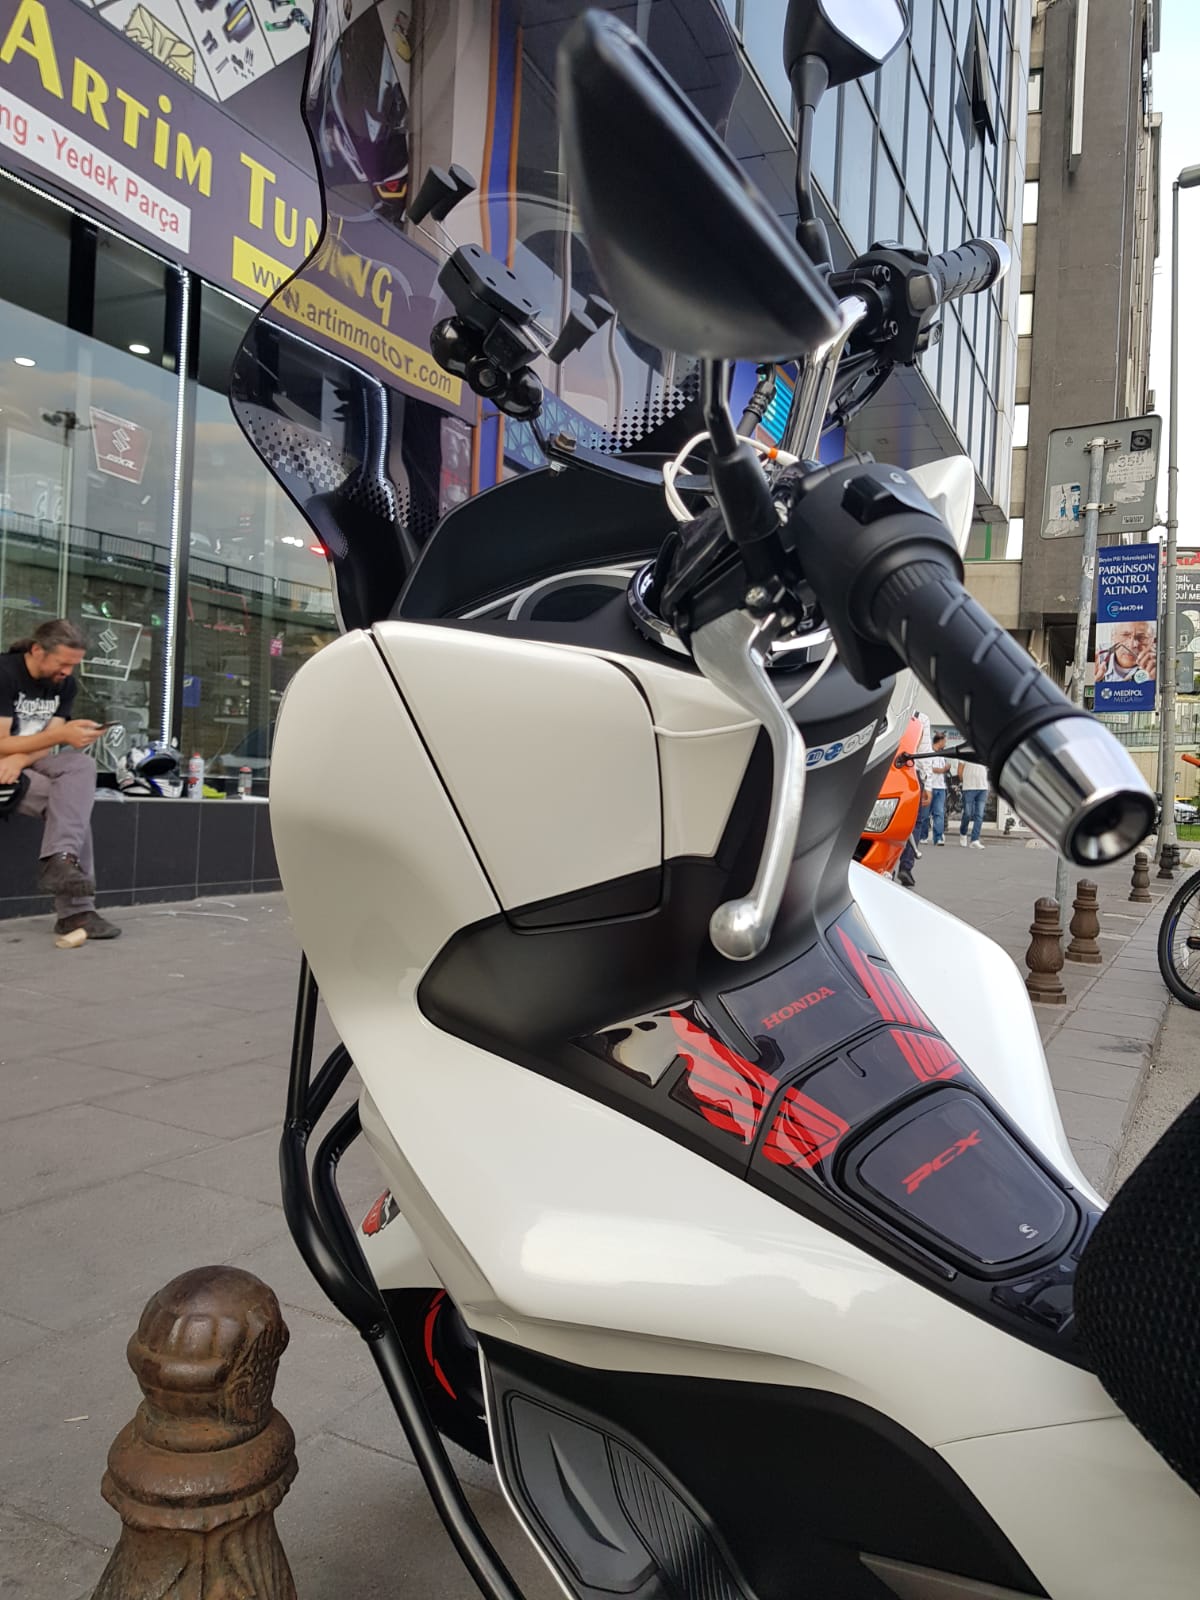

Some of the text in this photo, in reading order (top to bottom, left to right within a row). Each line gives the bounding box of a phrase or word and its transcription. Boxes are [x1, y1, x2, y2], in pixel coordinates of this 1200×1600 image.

[52, 129, 119, 196] Yedek
[125, 177, 180, 233] Parça
[1098, 562, 1155, 575] PARKİNSON
[1102, 574, 1151, 585] KONTROL
[1104, 585, 1148, 595] ALTINDA
[1113, 689, 1143, 697] MEDİPOL
[762, 986, 836, 1030] HONDA
[901, 1129, 983, 1194] PCX
